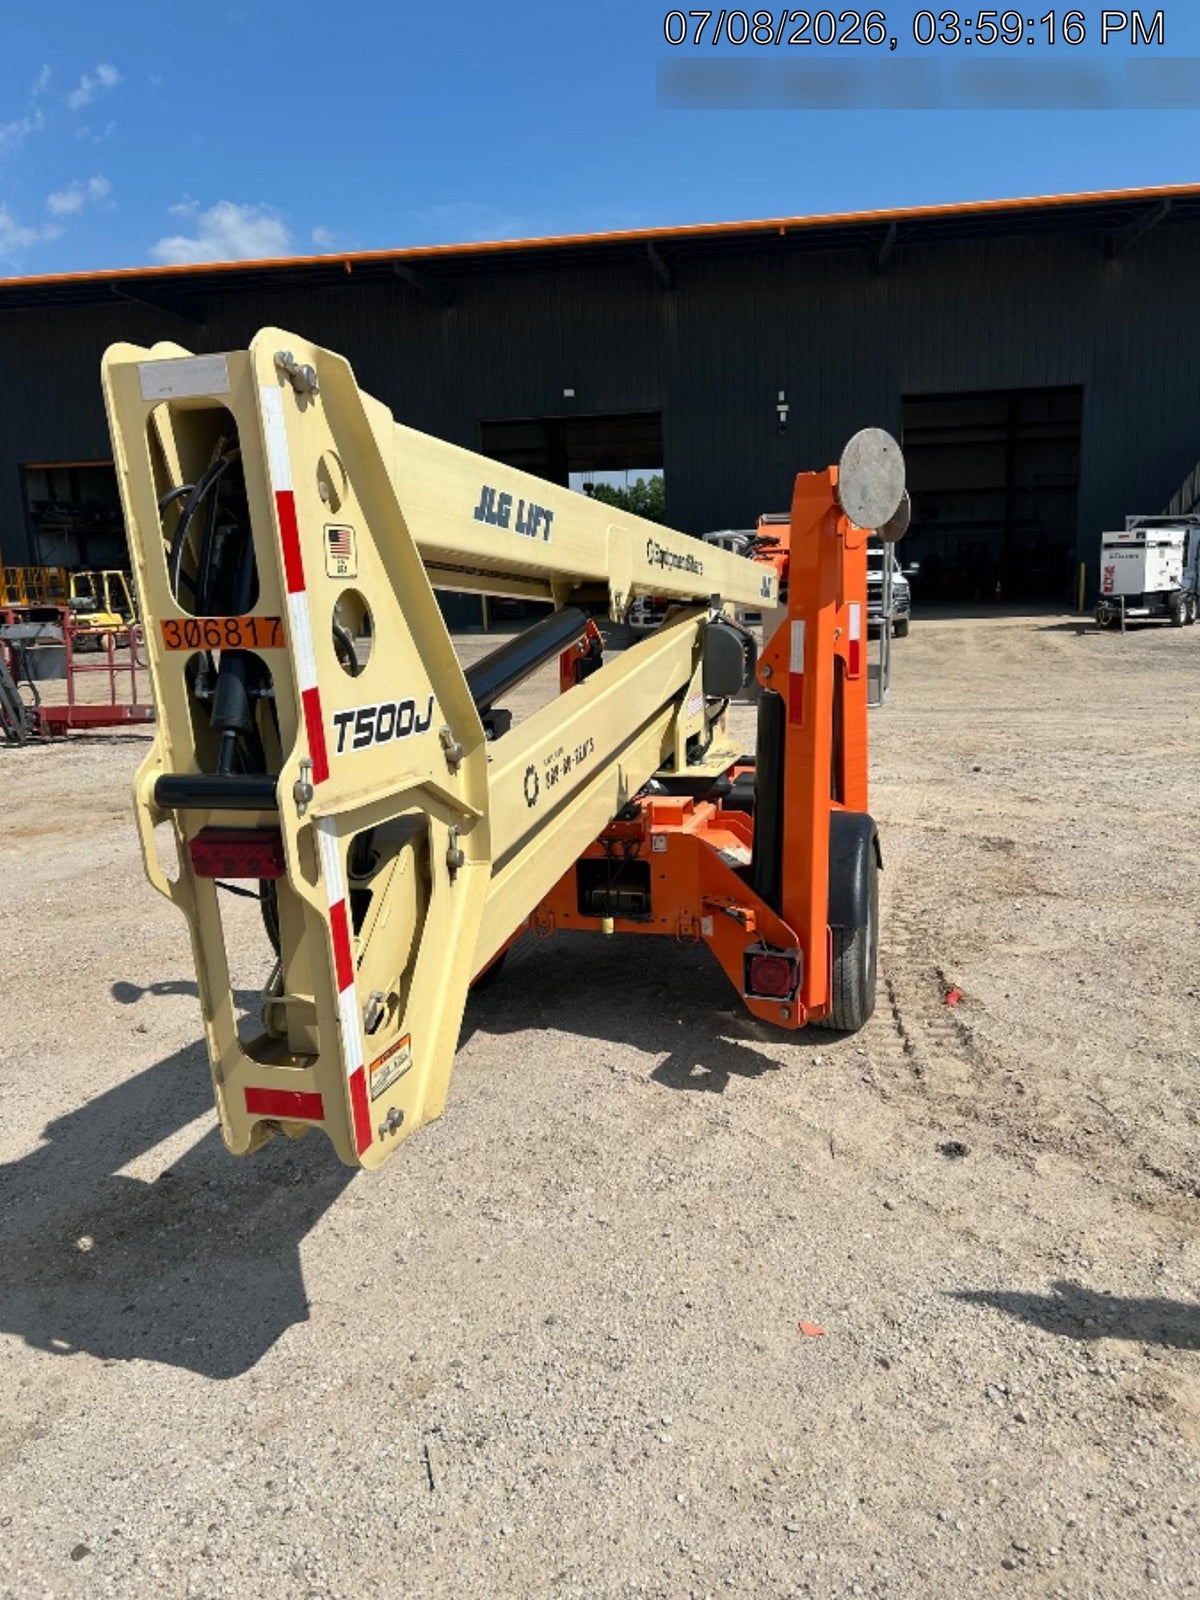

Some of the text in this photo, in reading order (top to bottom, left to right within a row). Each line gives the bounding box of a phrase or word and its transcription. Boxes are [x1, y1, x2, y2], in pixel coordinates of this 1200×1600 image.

[473, 484, 554, 542] JLG LIFT
[164, 616, 281, 649] 306817
[333, 695, 434, 753] T500J
